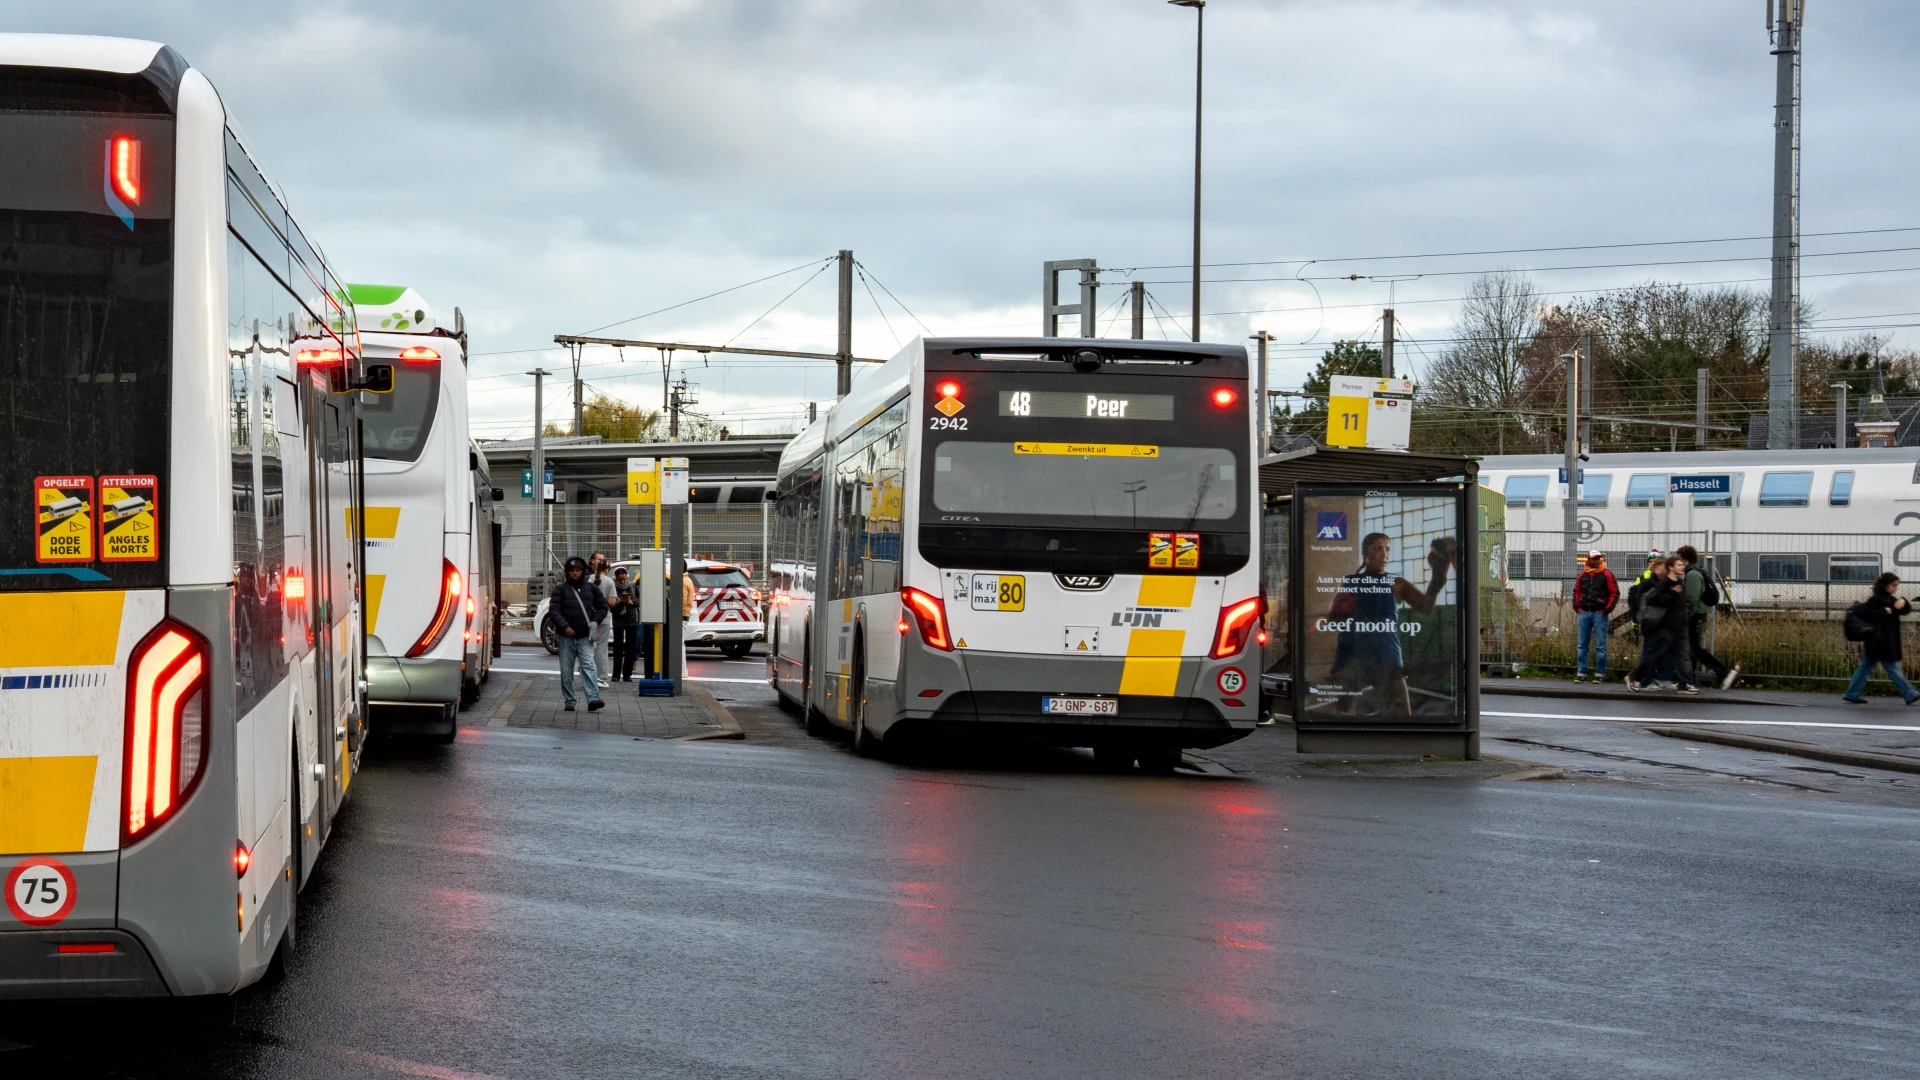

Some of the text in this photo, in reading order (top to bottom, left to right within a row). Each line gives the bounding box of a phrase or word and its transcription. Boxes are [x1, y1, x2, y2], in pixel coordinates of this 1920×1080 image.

[1010, 391, 1129, 417] 48 Peer
[929, 417, 968, 430] 2942
[1341, 412, 1359, 431] 11
[1067, 445, 1095, 453] Zwenkt
[43, 479, 86, 487] OPGELET
[102, 478, 154, 487] ATTENTION
[633, 481, 650, 494] 10
[1679, 478, 1720, 489] Hasselt
[1317, 526, 1342, 538] AXA
[50, 536, 81, 545] DODE
[109, 535, 150, 544] ANGLES
[50, 546, 81, 555] HOEK
[111, 544, 148, 554] MORTS
[1064, 576, 1101, 586] VDL
[1317, 576, 1334, 584] Aan
[1335, 576, 1350, 584] wie
[1361, 576, 1379, 584] elke
[1379, 576, 1396, 585] dag
[986, 581, 997, 593] rij
[1360, 585, 1392, 594] vechten
[999, 582, 1023, 604] 80
[974, 595, 996, 603] max
[1111, 612, 1162, 627] LIJN
[1315, 618, 1421, 636] Geef nooit op
[1224, 673, 1239, 685] 75
[22, 878, 59, 904] 75
